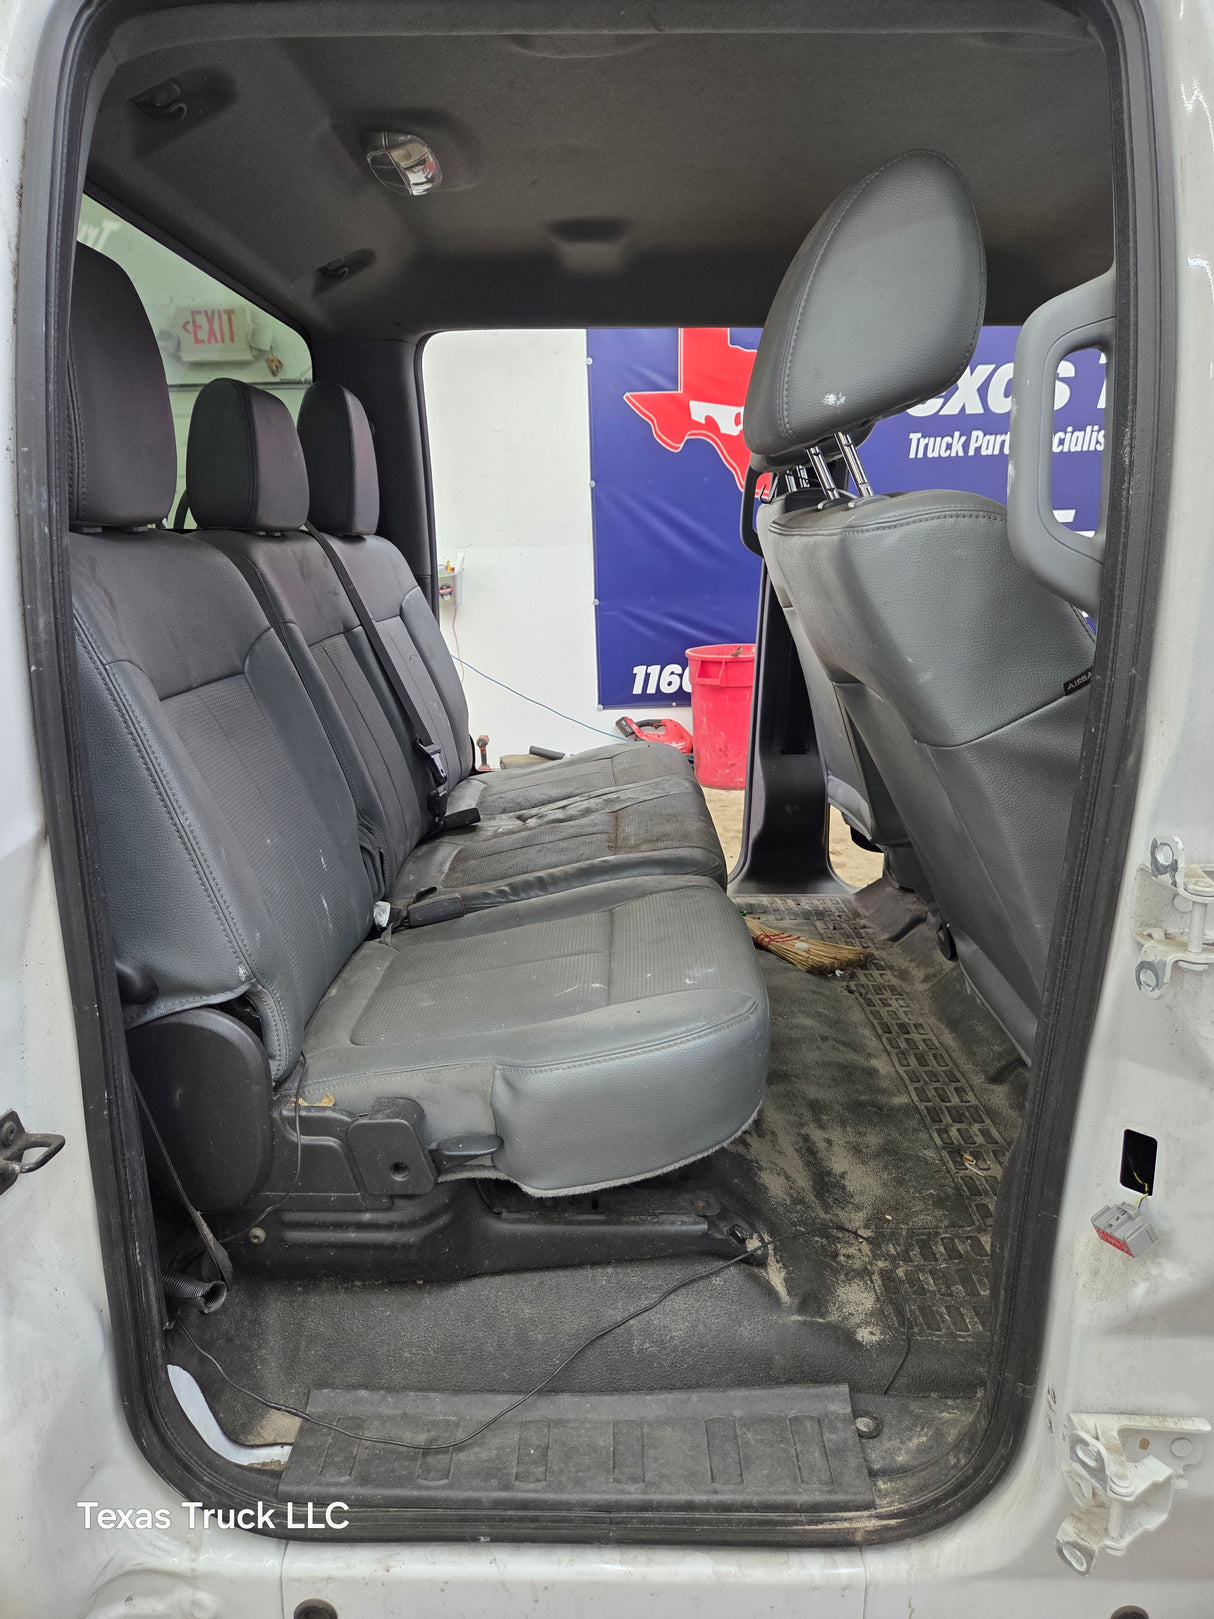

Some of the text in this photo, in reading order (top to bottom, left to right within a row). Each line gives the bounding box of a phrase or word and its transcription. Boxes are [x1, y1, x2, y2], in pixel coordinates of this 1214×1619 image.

[190, 308, 236, 345] EXIT
[909, 431, 967, 459] Truck
[968, 430, 1010, 456] Part
[1067, 671, 1093, 690] AIRBA
